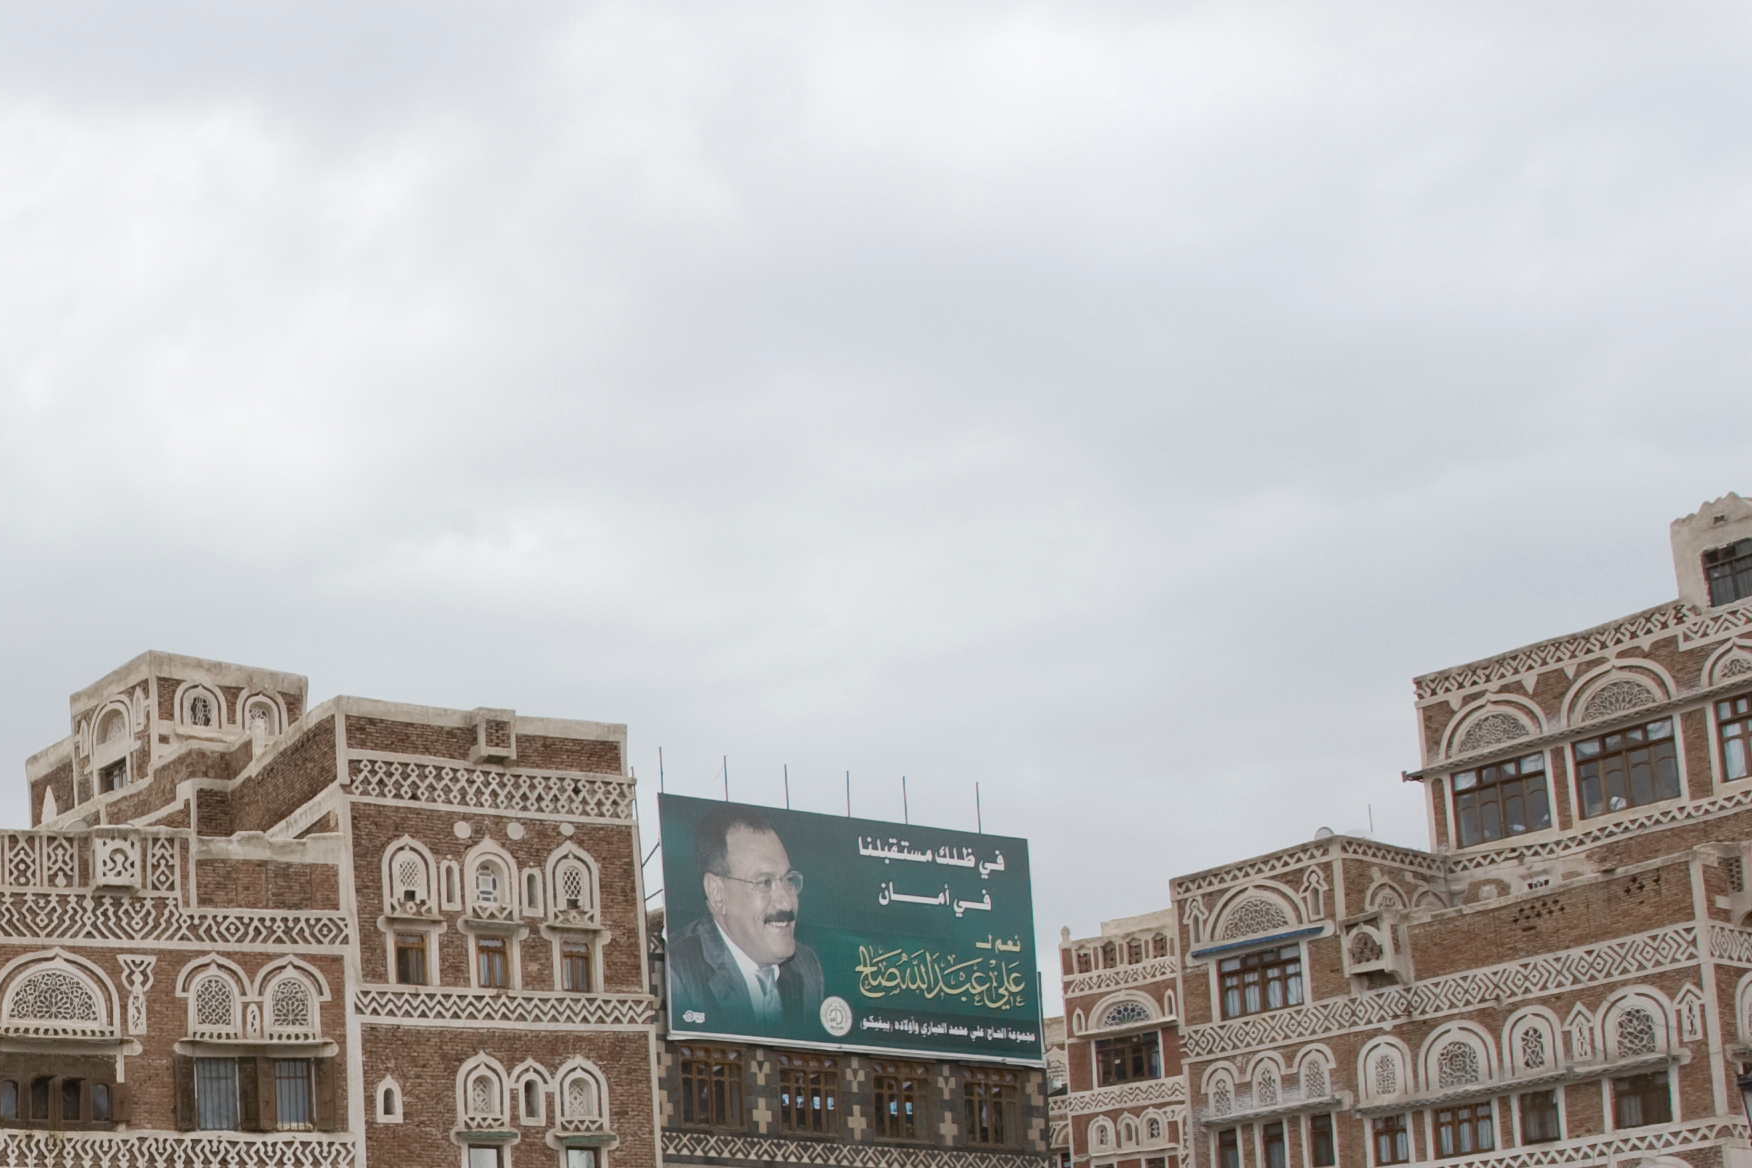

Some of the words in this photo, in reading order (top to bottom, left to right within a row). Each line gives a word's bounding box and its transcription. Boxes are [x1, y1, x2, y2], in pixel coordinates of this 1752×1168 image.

[858, 835, 933, 865] مستقبلنا
[935, 845, 976, 868] ظلك
[978, 849, 1005, 880] في
[878, 881, 950, 906] أمان
[953, 888, 992, 918] في
[995, 935, 1021, 955] نعم
[948, 1024, 969, 1036] محمد
